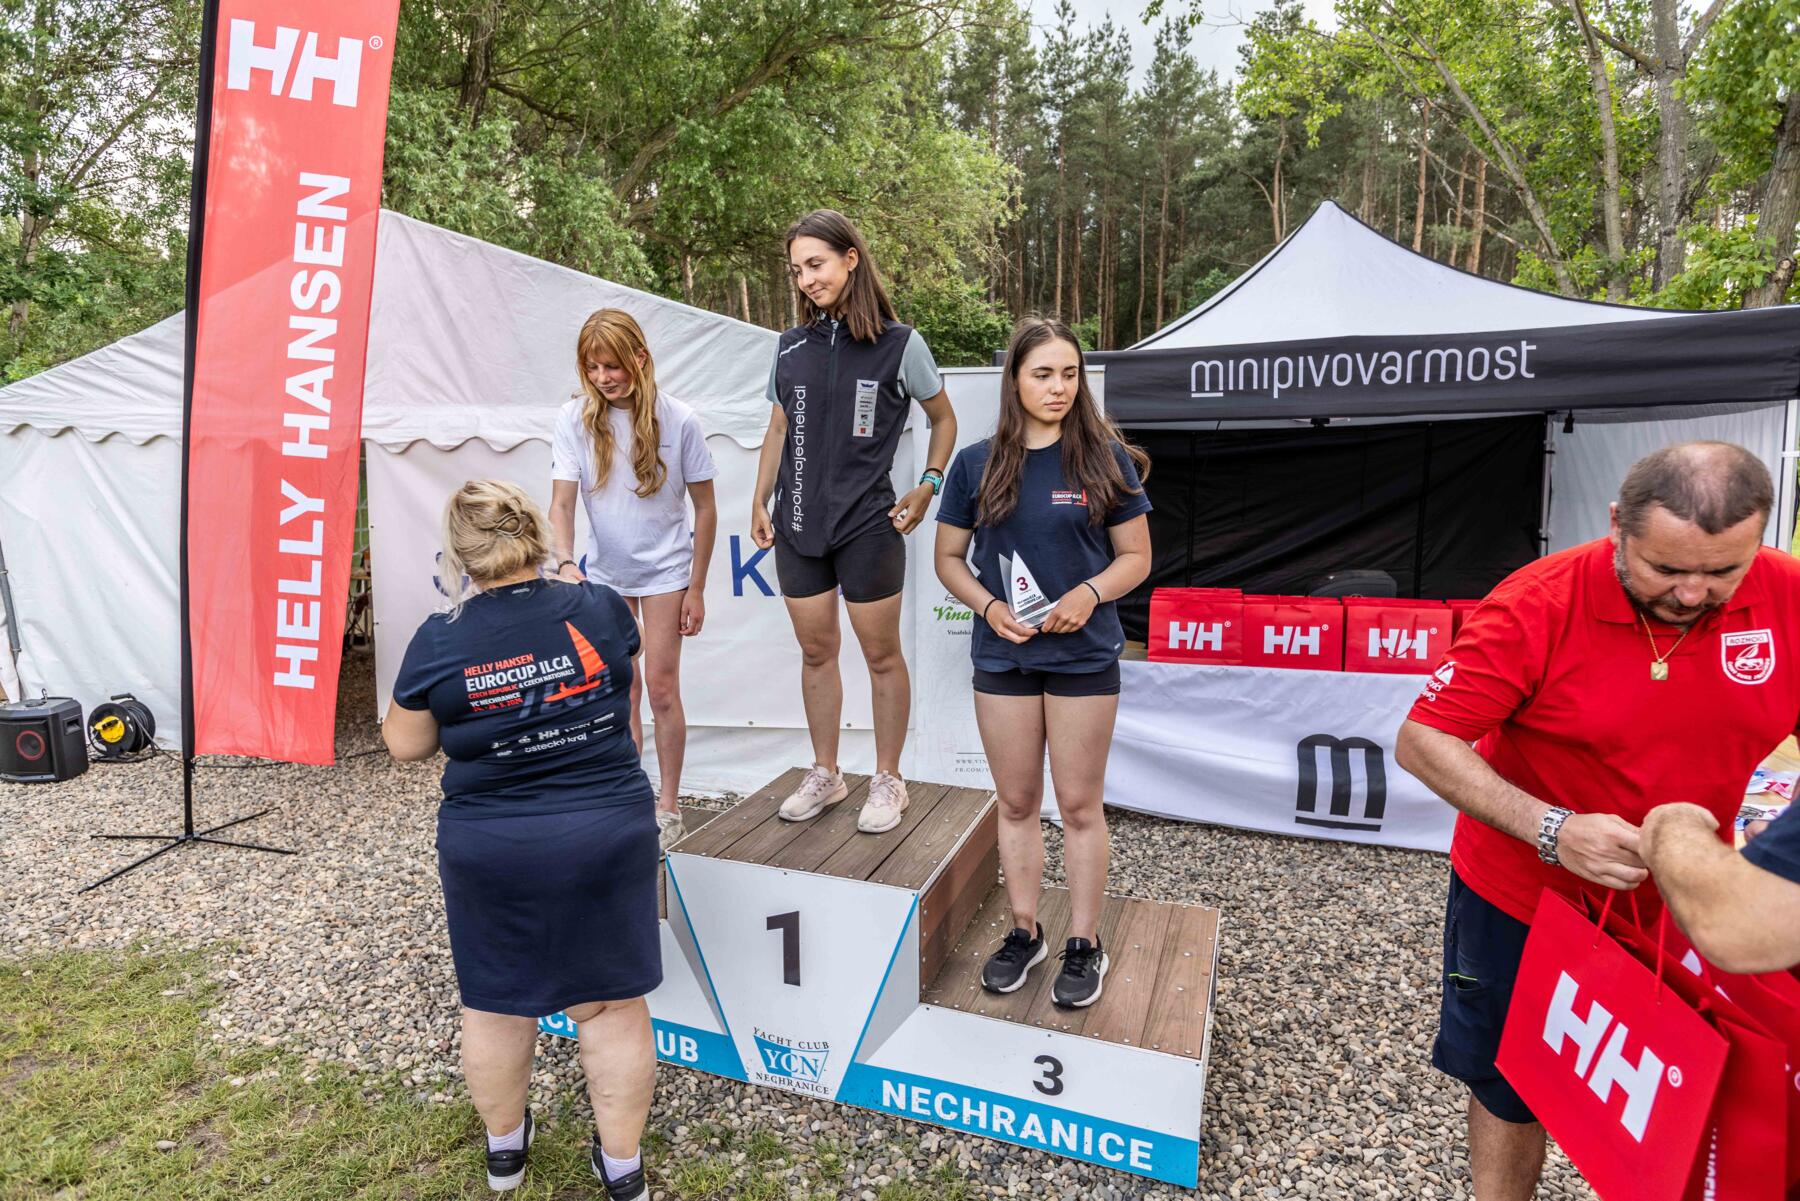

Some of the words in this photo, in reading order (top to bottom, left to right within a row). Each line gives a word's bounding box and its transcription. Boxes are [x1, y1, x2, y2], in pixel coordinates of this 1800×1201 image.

[281, 171, 350, 459] HANSEN
[1191, 340, 1537, 398] minipivovarmost
[791, 384, 806, 532] #spolunajednelodi
[273, 478, 325, 690] HELLY
[1016, 576, 1029, 591] 3
[464, 663, 494, 677] HELLY
[495, 653, 534, 670] HANSEN
[466, 665, 537, 692] EUROCUP
[541, 655, 573, 675] ILCA
[524, 677, 544, 688] CZECH
[543, 668, 576, 683] NATIONALS
[766, 911, 801, 987] 1
[753, 1026, 792, 1047] YACHT
[798, 1041, 830, 1050] CLUB
[764, 1048, 819, 1078] YCN
[1032, 1054, 1064, 1096] 3
[882, 1079, 1153, 1171] NECHRANICE
